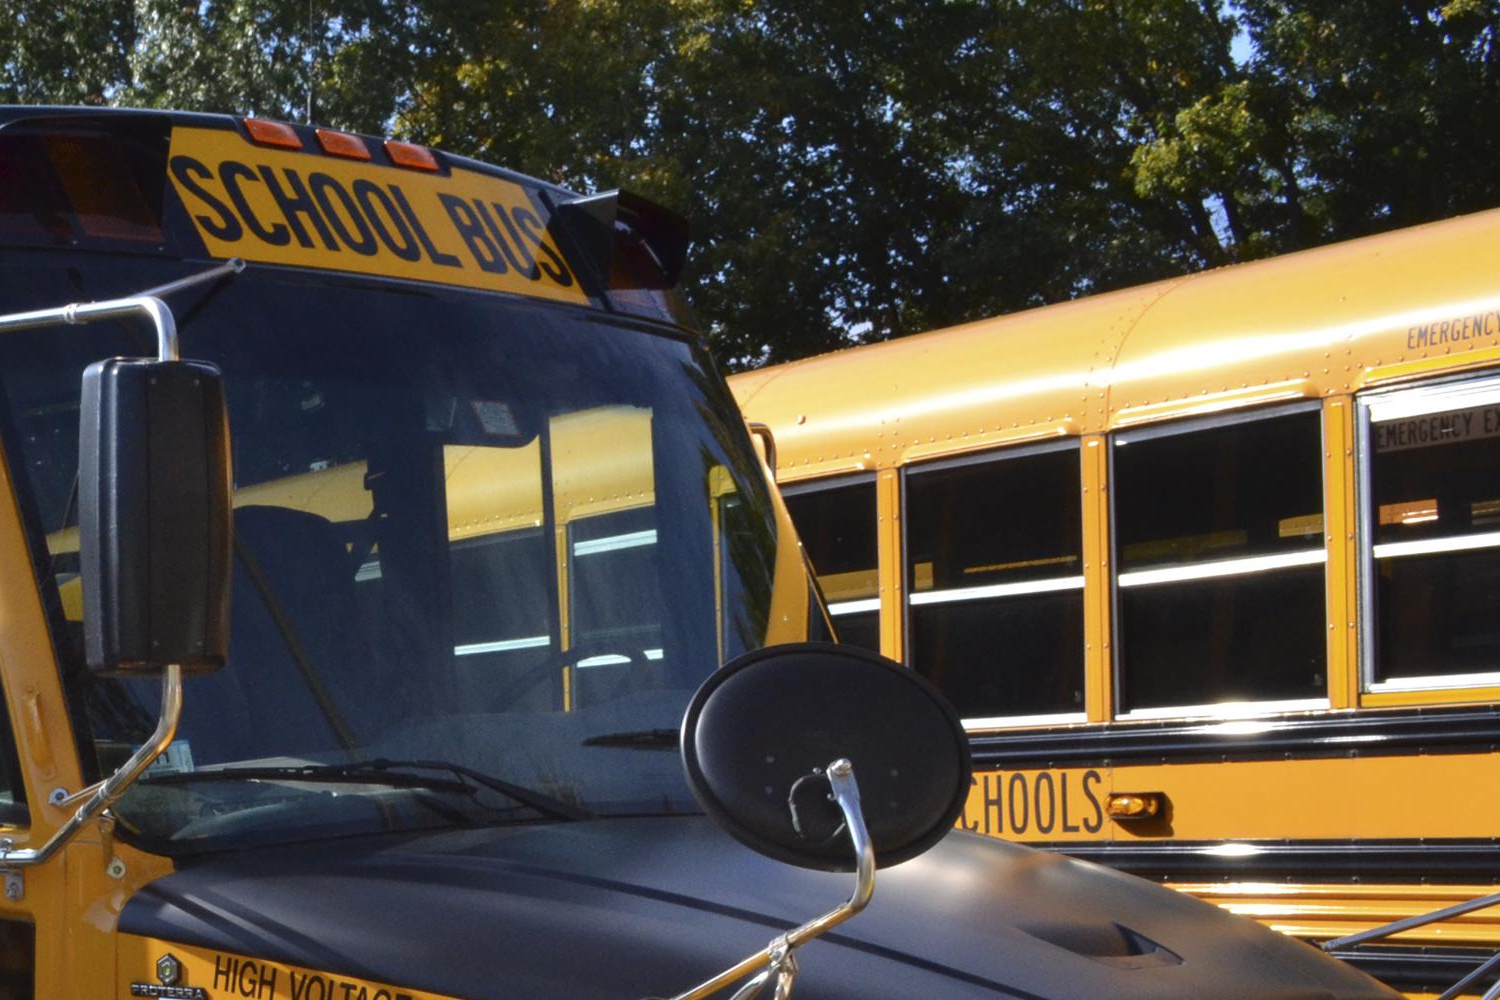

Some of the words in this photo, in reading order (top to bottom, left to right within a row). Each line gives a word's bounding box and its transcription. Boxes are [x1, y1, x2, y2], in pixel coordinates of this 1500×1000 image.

[169, 155, 463, 269] SCHOOL
[436, 191, 573, 287] BUS
[1378, 411, 1474, 449] EMERGENCY
[131, 983, 204, 999] PROTERRA
